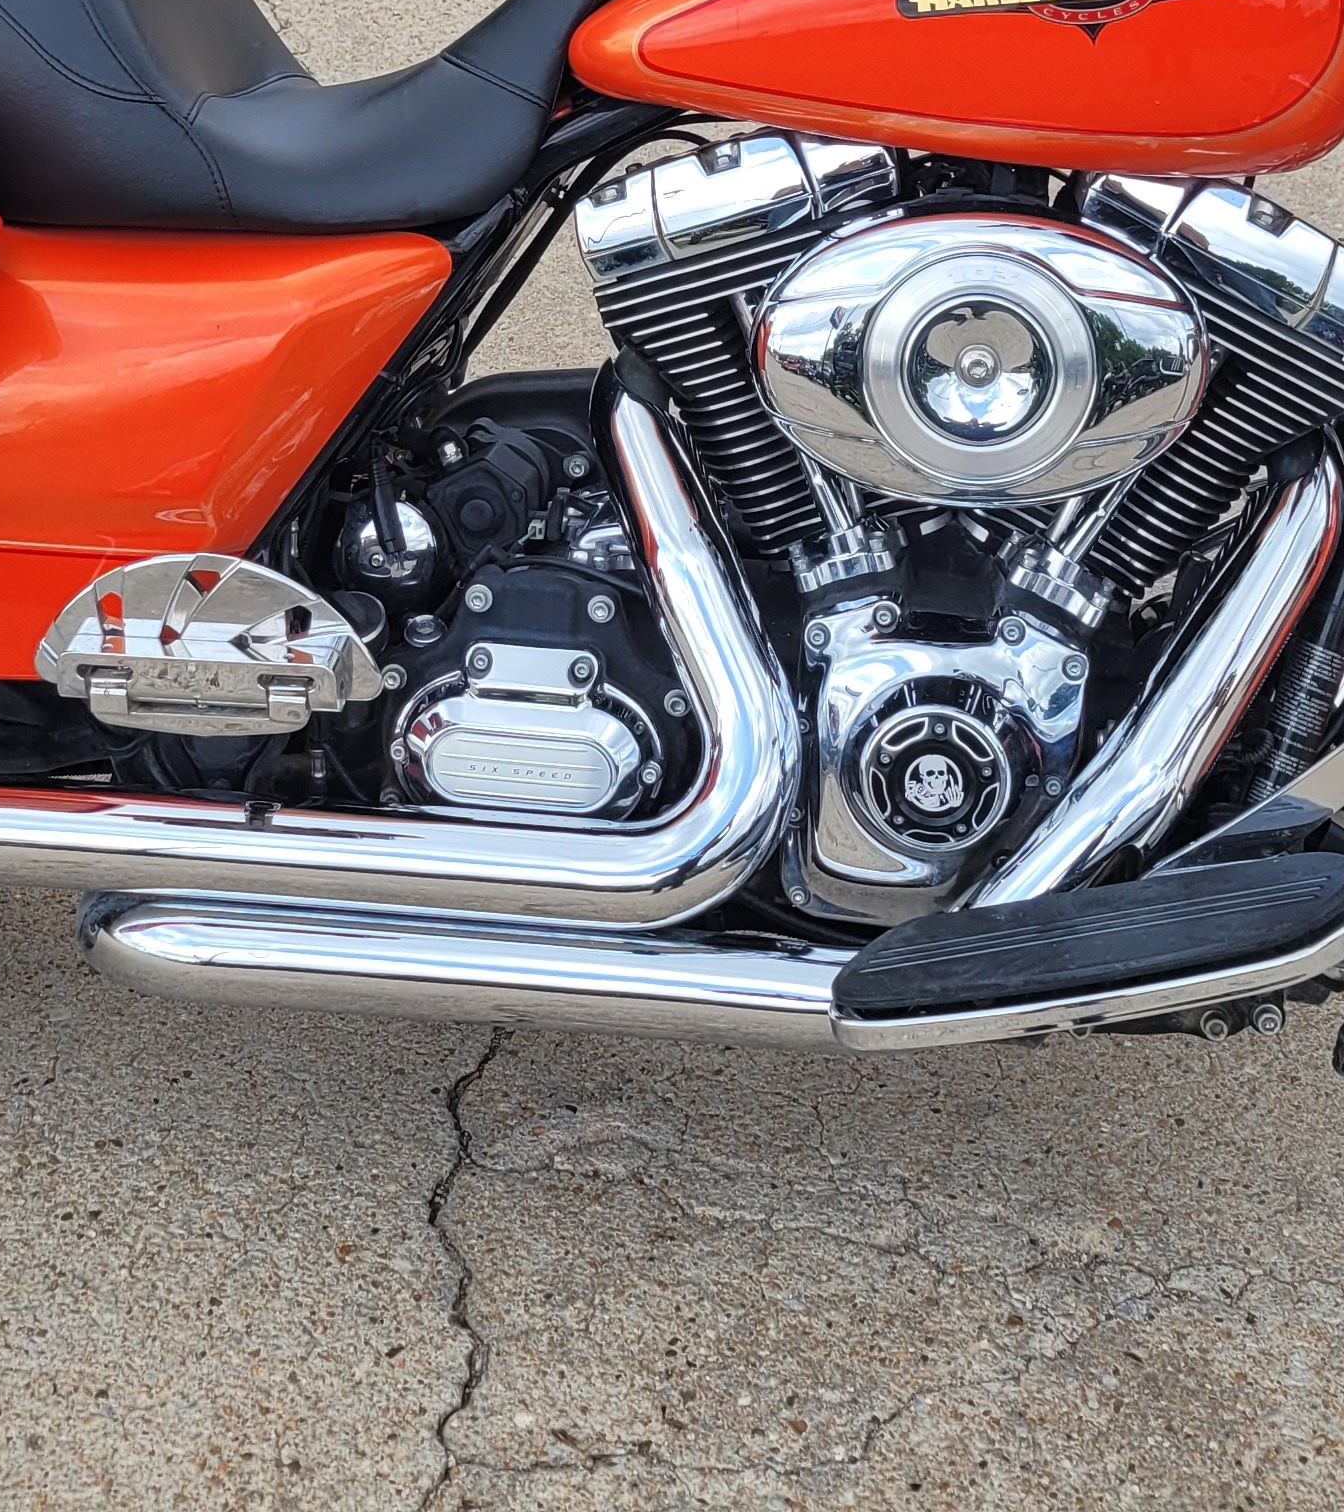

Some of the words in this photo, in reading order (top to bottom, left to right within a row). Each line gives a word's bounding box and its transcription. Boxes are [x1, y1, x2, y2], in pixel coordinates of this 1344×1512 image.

[1042, 0, 1140, 22] CYCLES
[468, 763, 499, 774] SIX
[512, 767, 573, 781] SPEED
